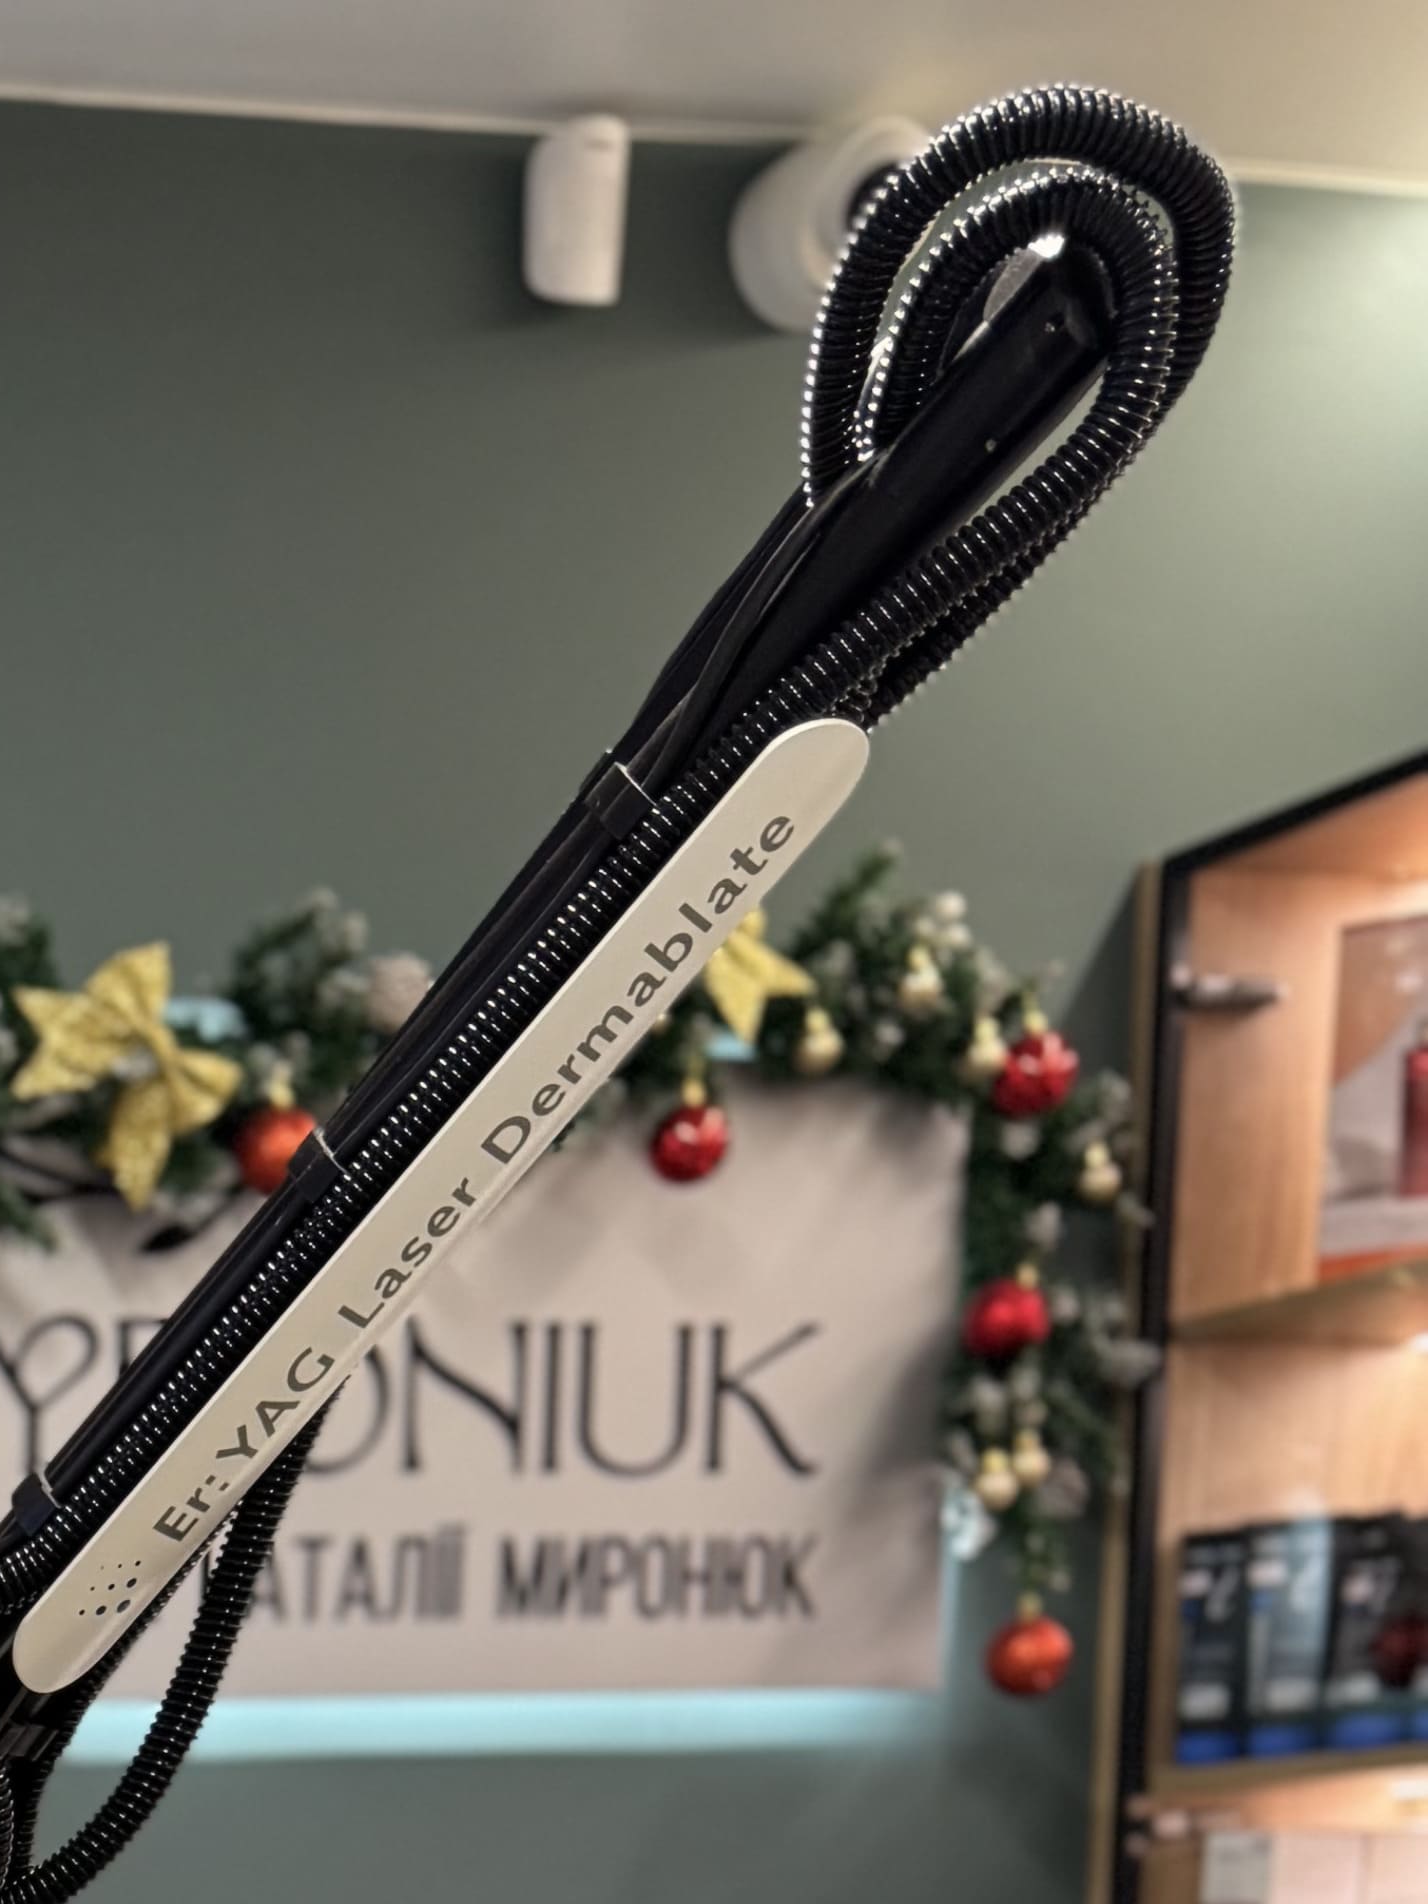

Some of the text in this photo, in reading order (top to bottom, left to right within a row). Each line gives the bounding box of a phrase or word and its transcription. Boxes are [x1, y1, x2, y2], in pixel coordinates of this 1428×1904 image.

[338, 1177, 478, 1329] Laser
[481, 815, 795, 1165] Dermablate
[201, 1521, 467, 1625] АТАЛІЇ
[494, 1531, 822, 1625] МИРОНЮК
